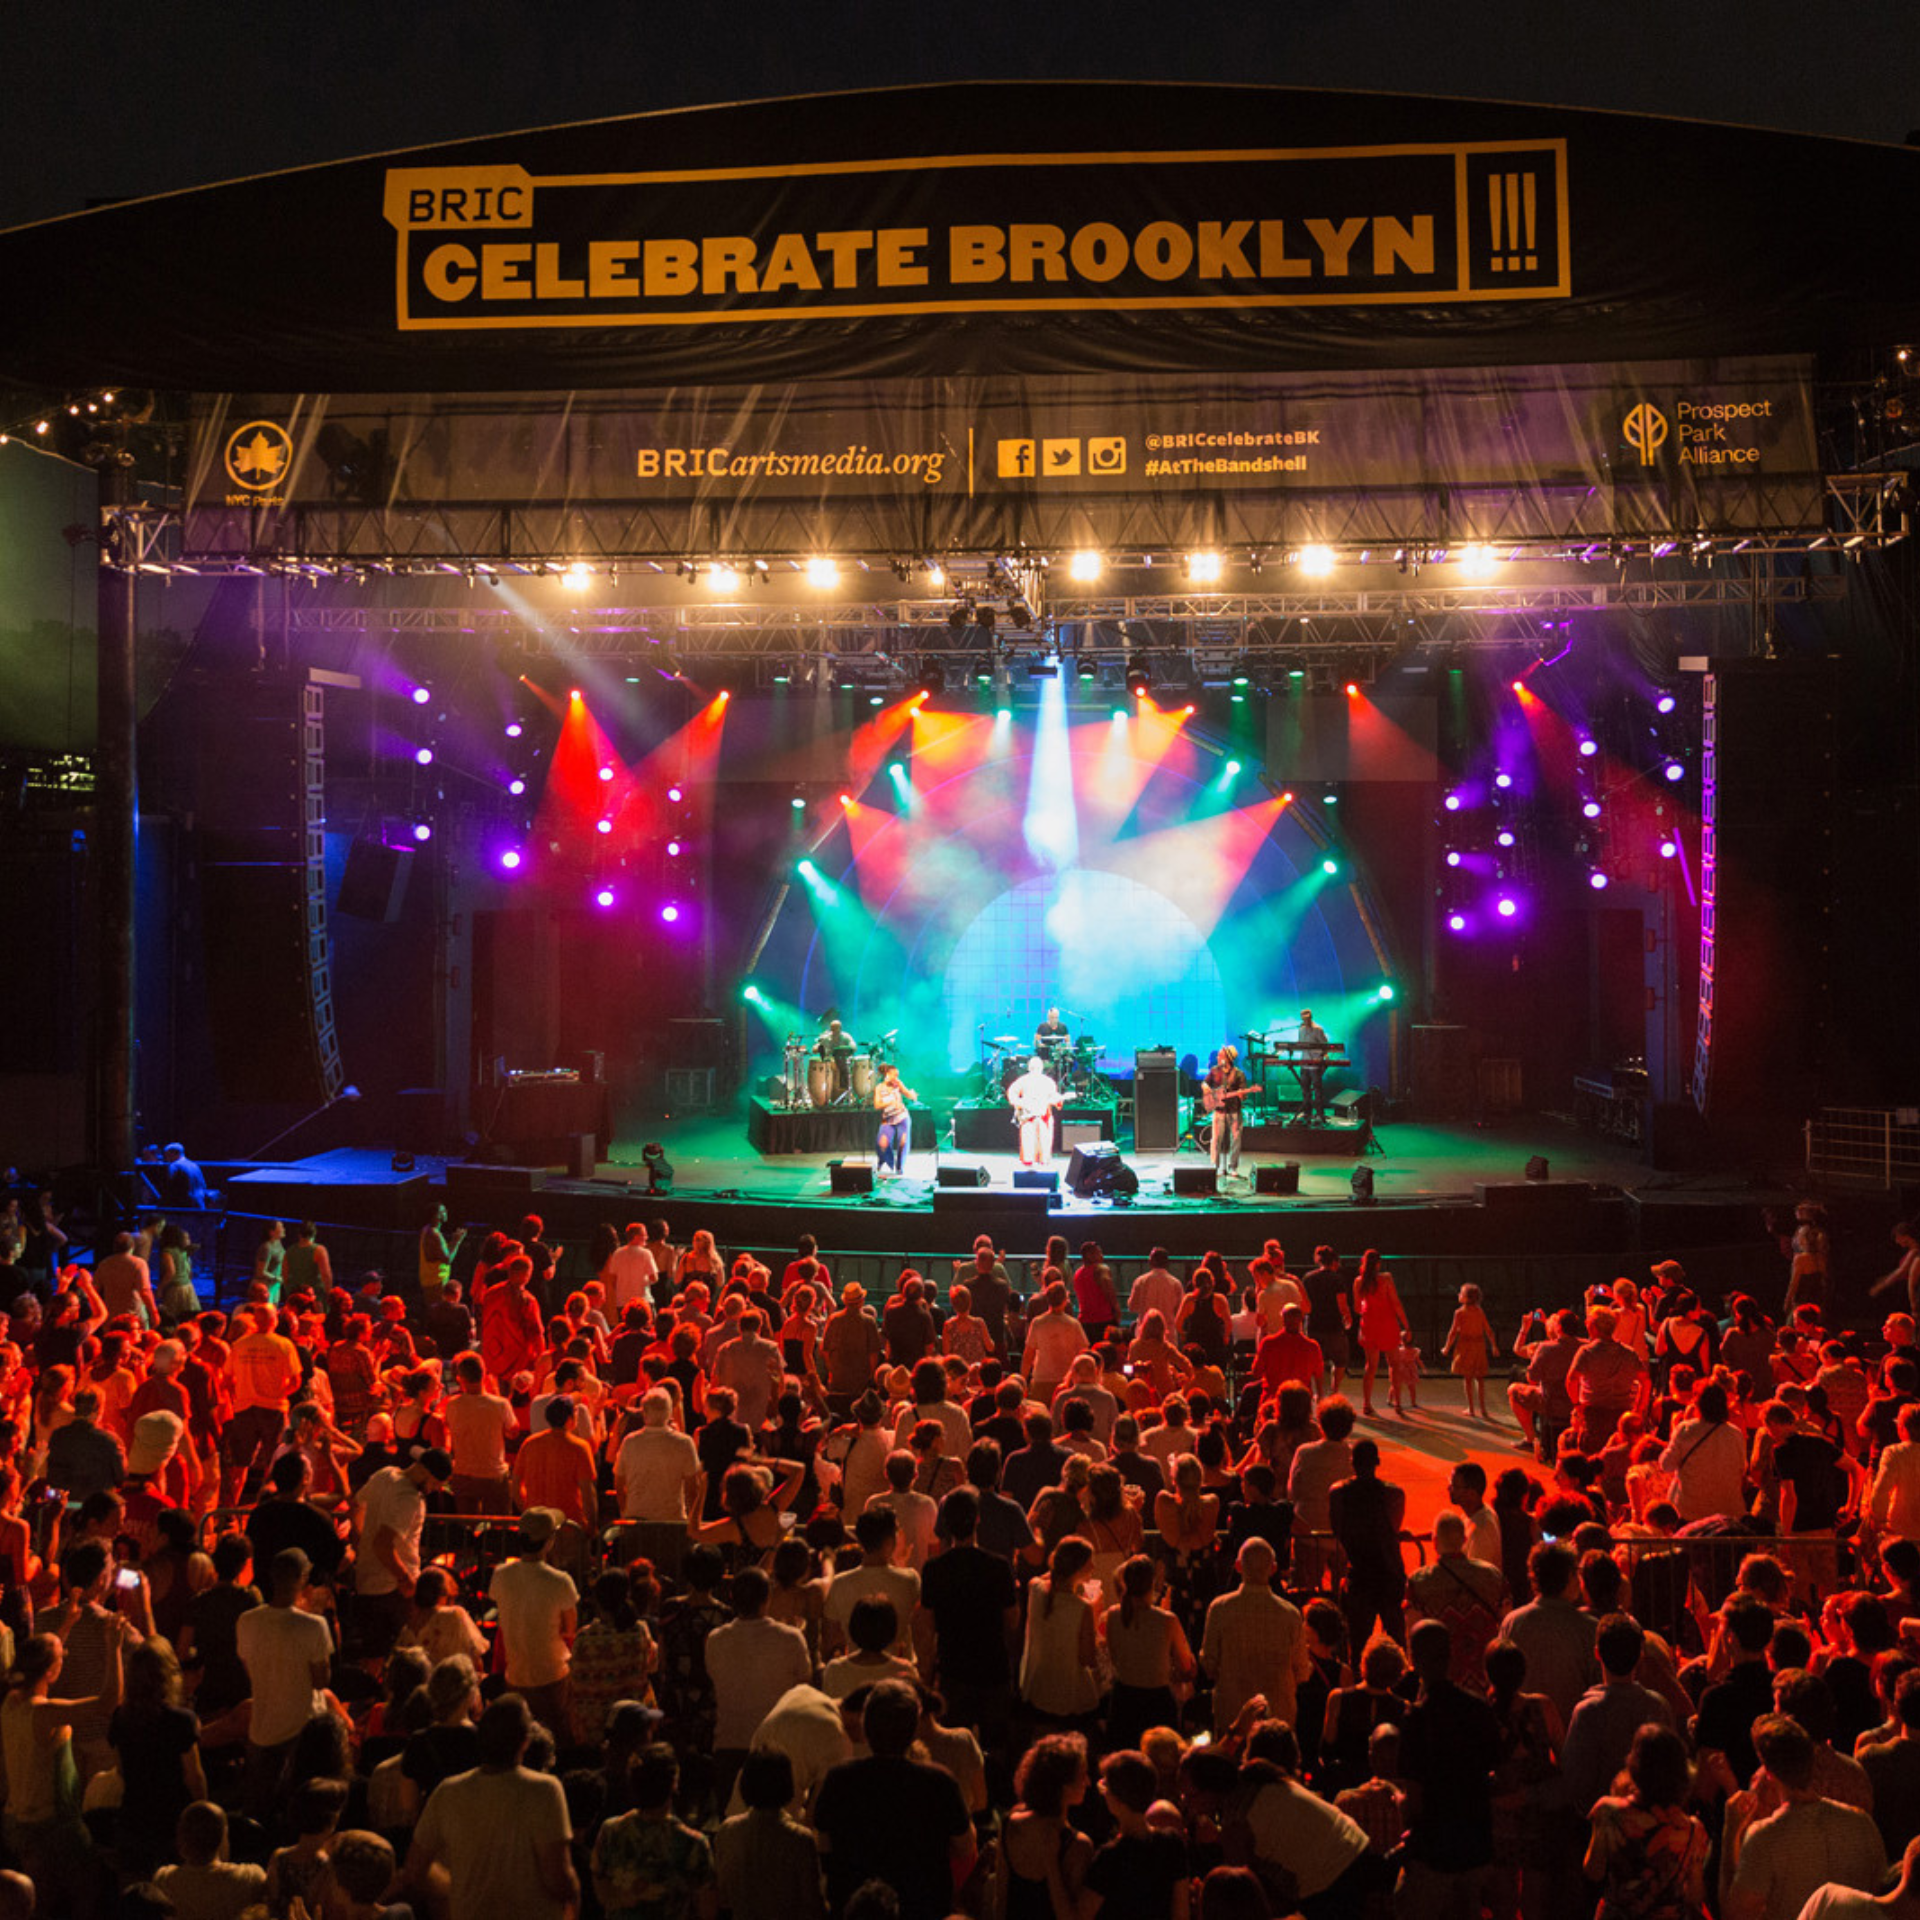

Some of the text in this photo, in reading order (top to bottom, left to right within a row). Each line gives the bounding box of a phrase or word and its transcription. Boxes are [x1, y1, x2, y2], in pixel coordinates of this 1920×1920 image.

[409, 187, 524, 223] BRIC
[422, 226, 929, 303] CELEBRATE
[949, 215, 1435, 284] BROOKLYN
[1678, 400, 1771, 422] Prospect
[1145, 429, 1321, 451] @BRICcelebrateBK
[1679, 423, 1726, 442] Park
[636, 446, 946, 484] BRICartsmedia.org
[1144, 455, 1308, 477] #AtTheBandshell
[1679, 447, 1759, 465] Alliance
[225, 494, 250, 507] NYC
